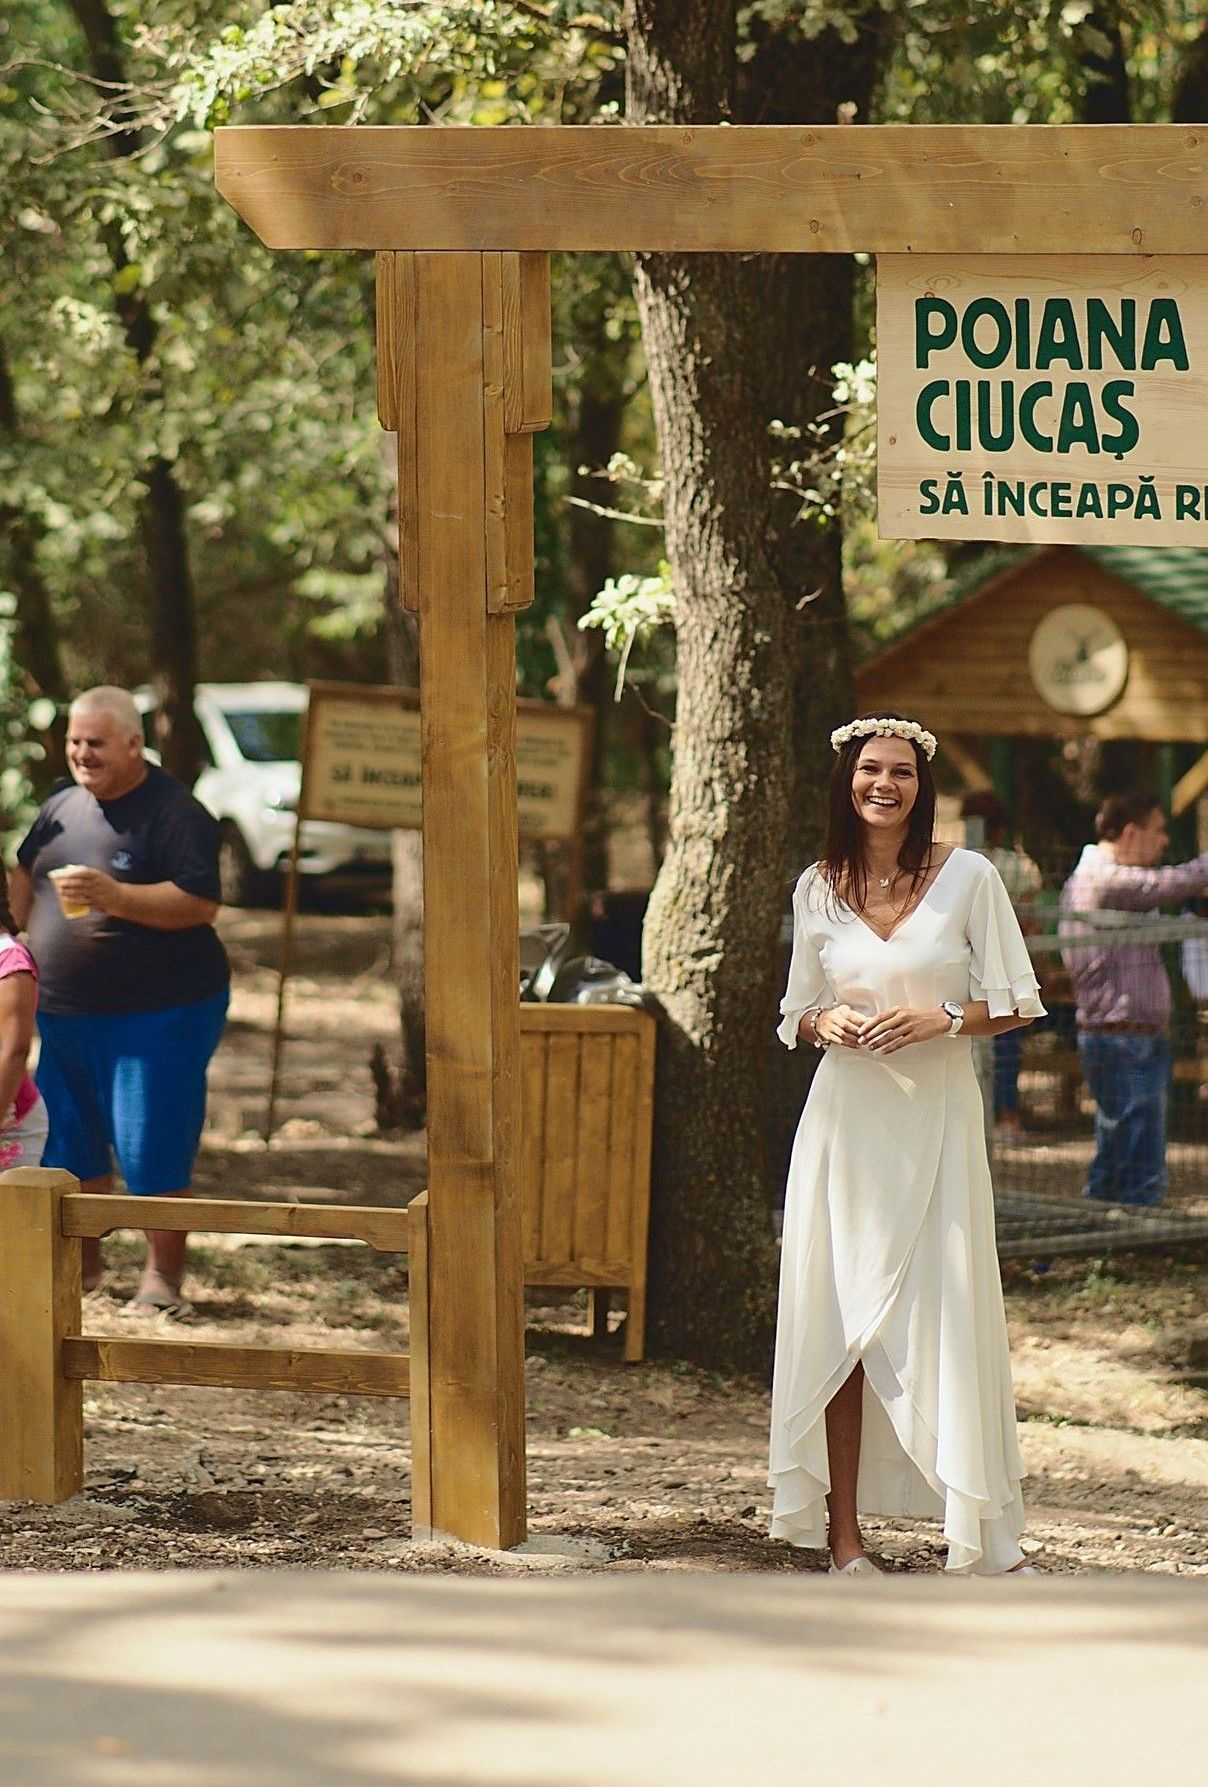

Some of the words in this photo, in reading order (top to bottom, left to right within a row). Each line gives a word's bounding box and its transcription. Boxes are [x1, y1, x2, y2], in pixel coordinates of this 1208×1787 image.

[914, 296, 1190, 372] POIANA
[915, 378, 1141, 461] CIUCAȘ
[918, 470, 969, 517] SĂ
[981, 470, 1163, 521] ÎNCEAPĂ
